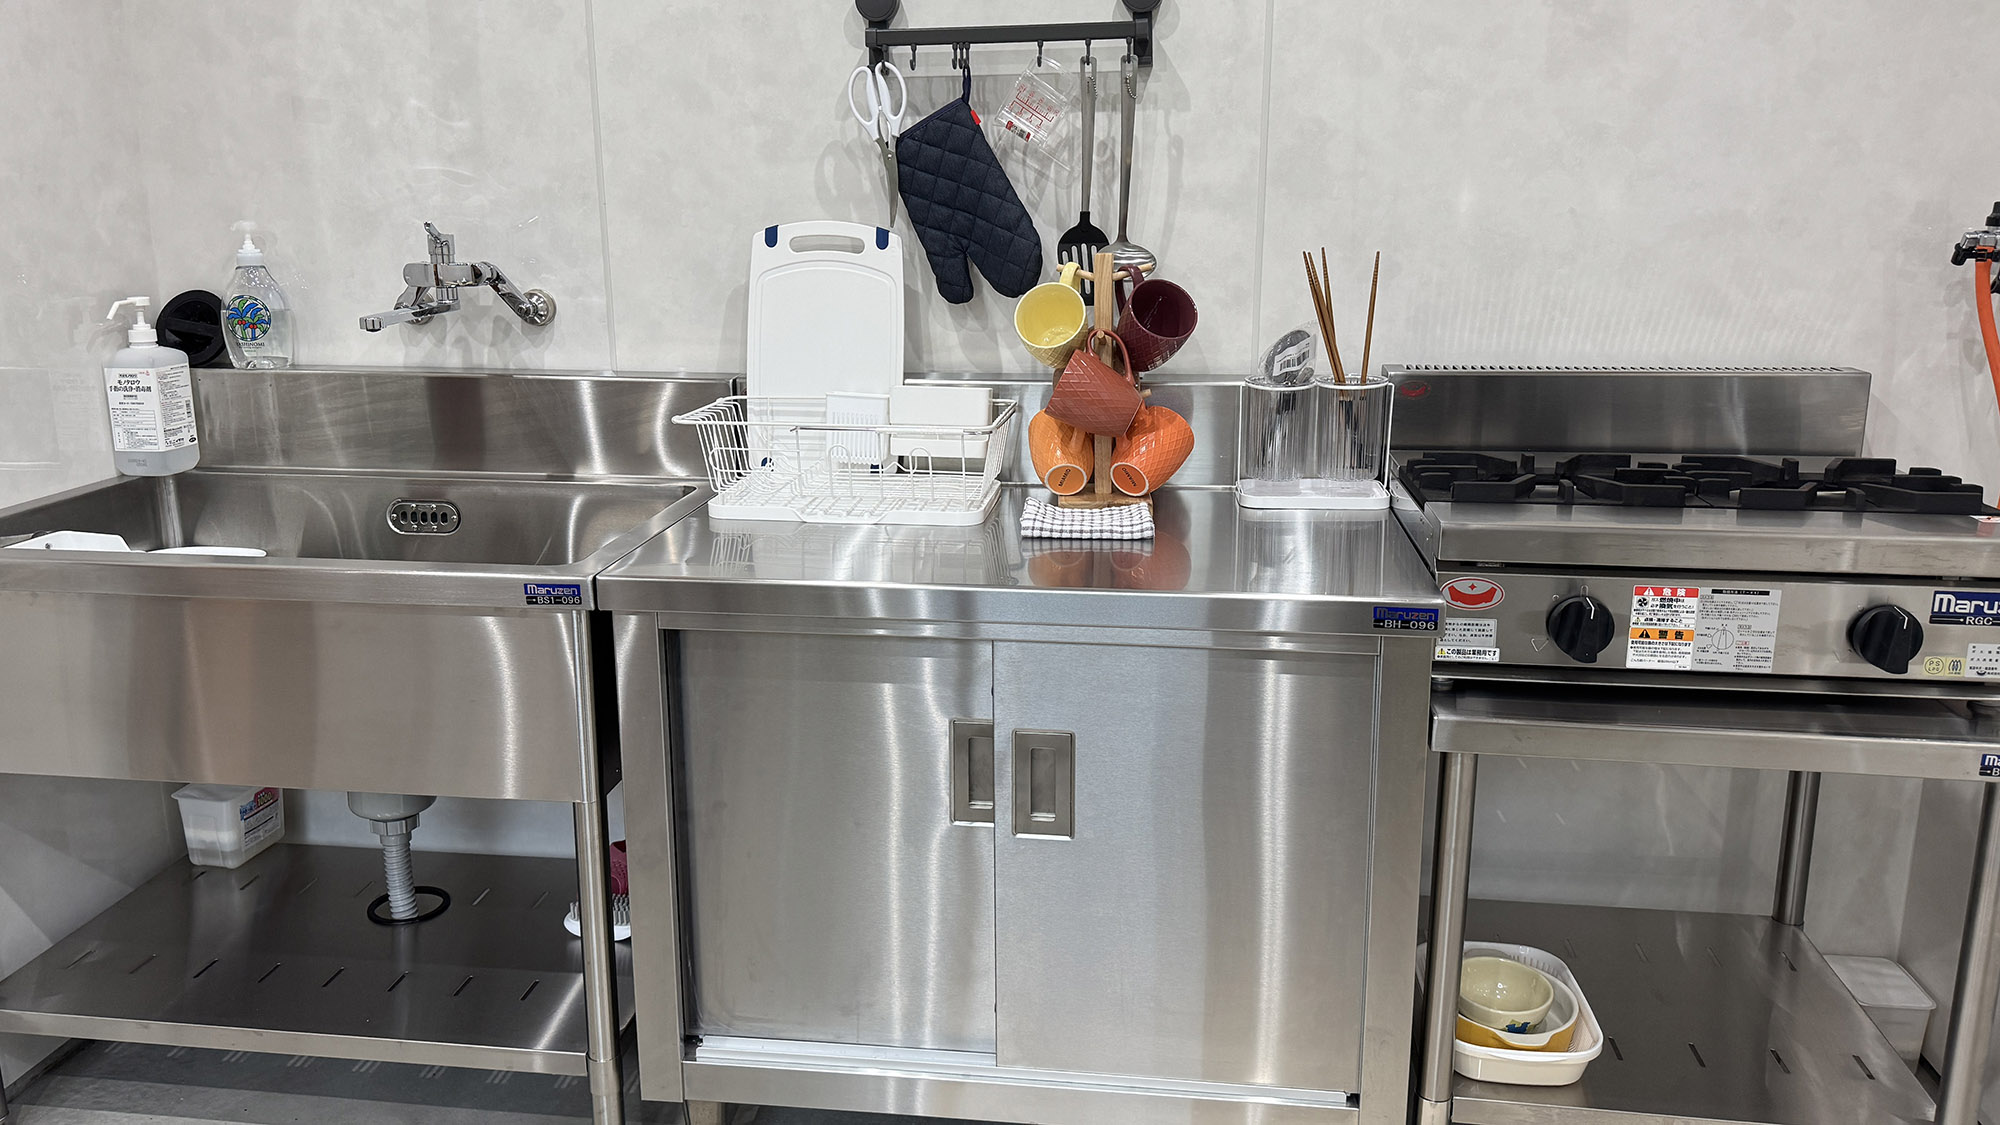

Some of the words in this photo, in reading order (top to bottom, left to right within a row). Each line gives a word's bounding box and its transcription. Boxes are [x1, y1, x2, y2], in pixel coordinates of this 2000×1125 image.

[527, 584, 578, 595] Maruzen
[1933, 594, 2000, 614] Maru
[1376, 607, 1435, 620] Maruzen
